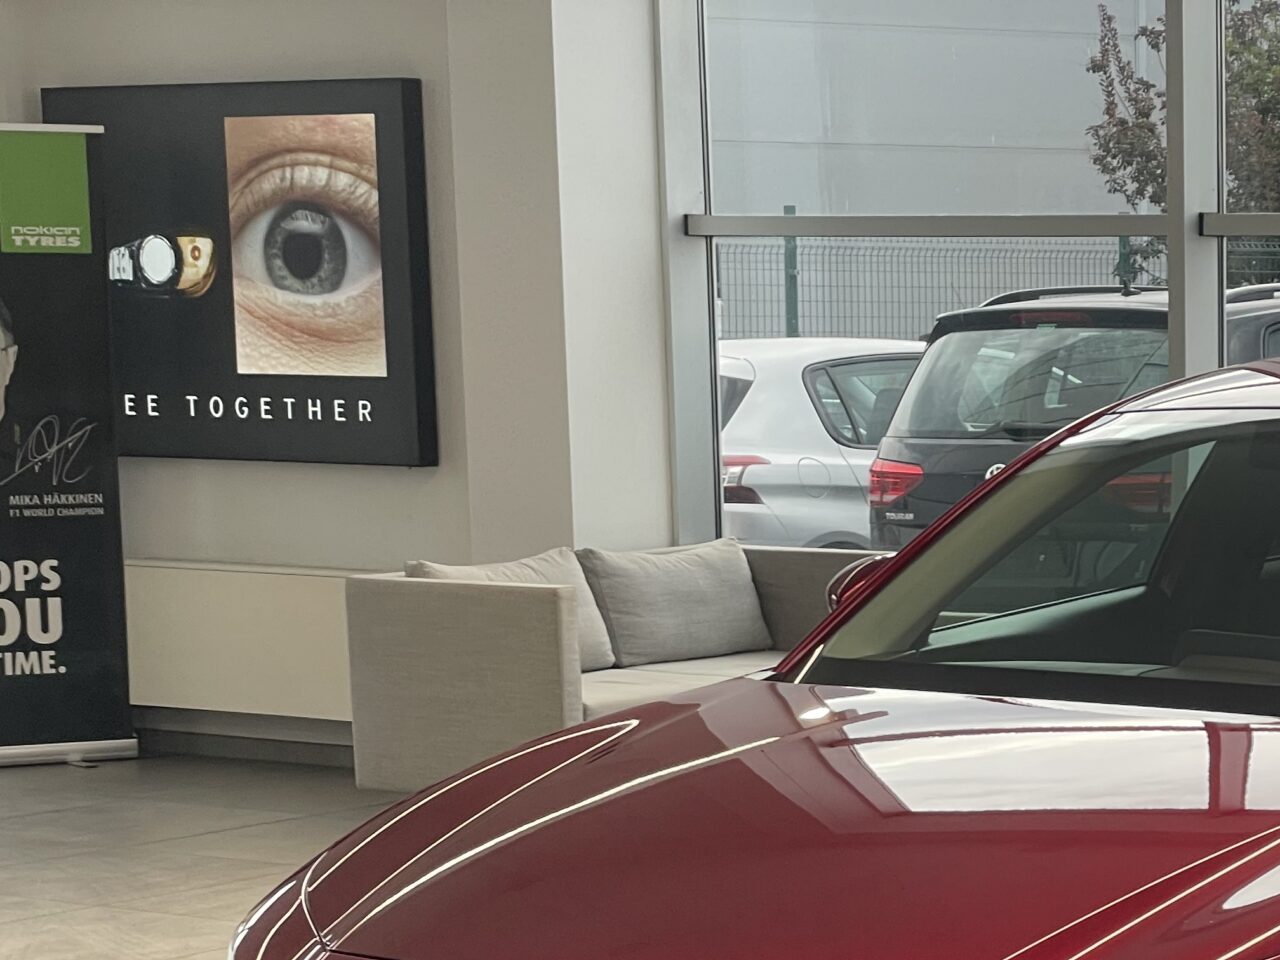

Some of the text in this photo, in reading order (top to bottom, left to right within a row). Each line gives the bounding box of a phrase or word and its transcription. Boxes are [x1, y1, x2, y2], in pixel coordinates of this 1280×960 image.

[11, 235, 81, 247] TYRES
[186, 395, 372, 422] TOGETHER
[9, 492, 103, 505] MIKA HÄKKINEN
[22, 508, 55, 517] WORLD
[56, 507, 104, 516] CHAMPION
[0, 650, 67, 676] IME.
